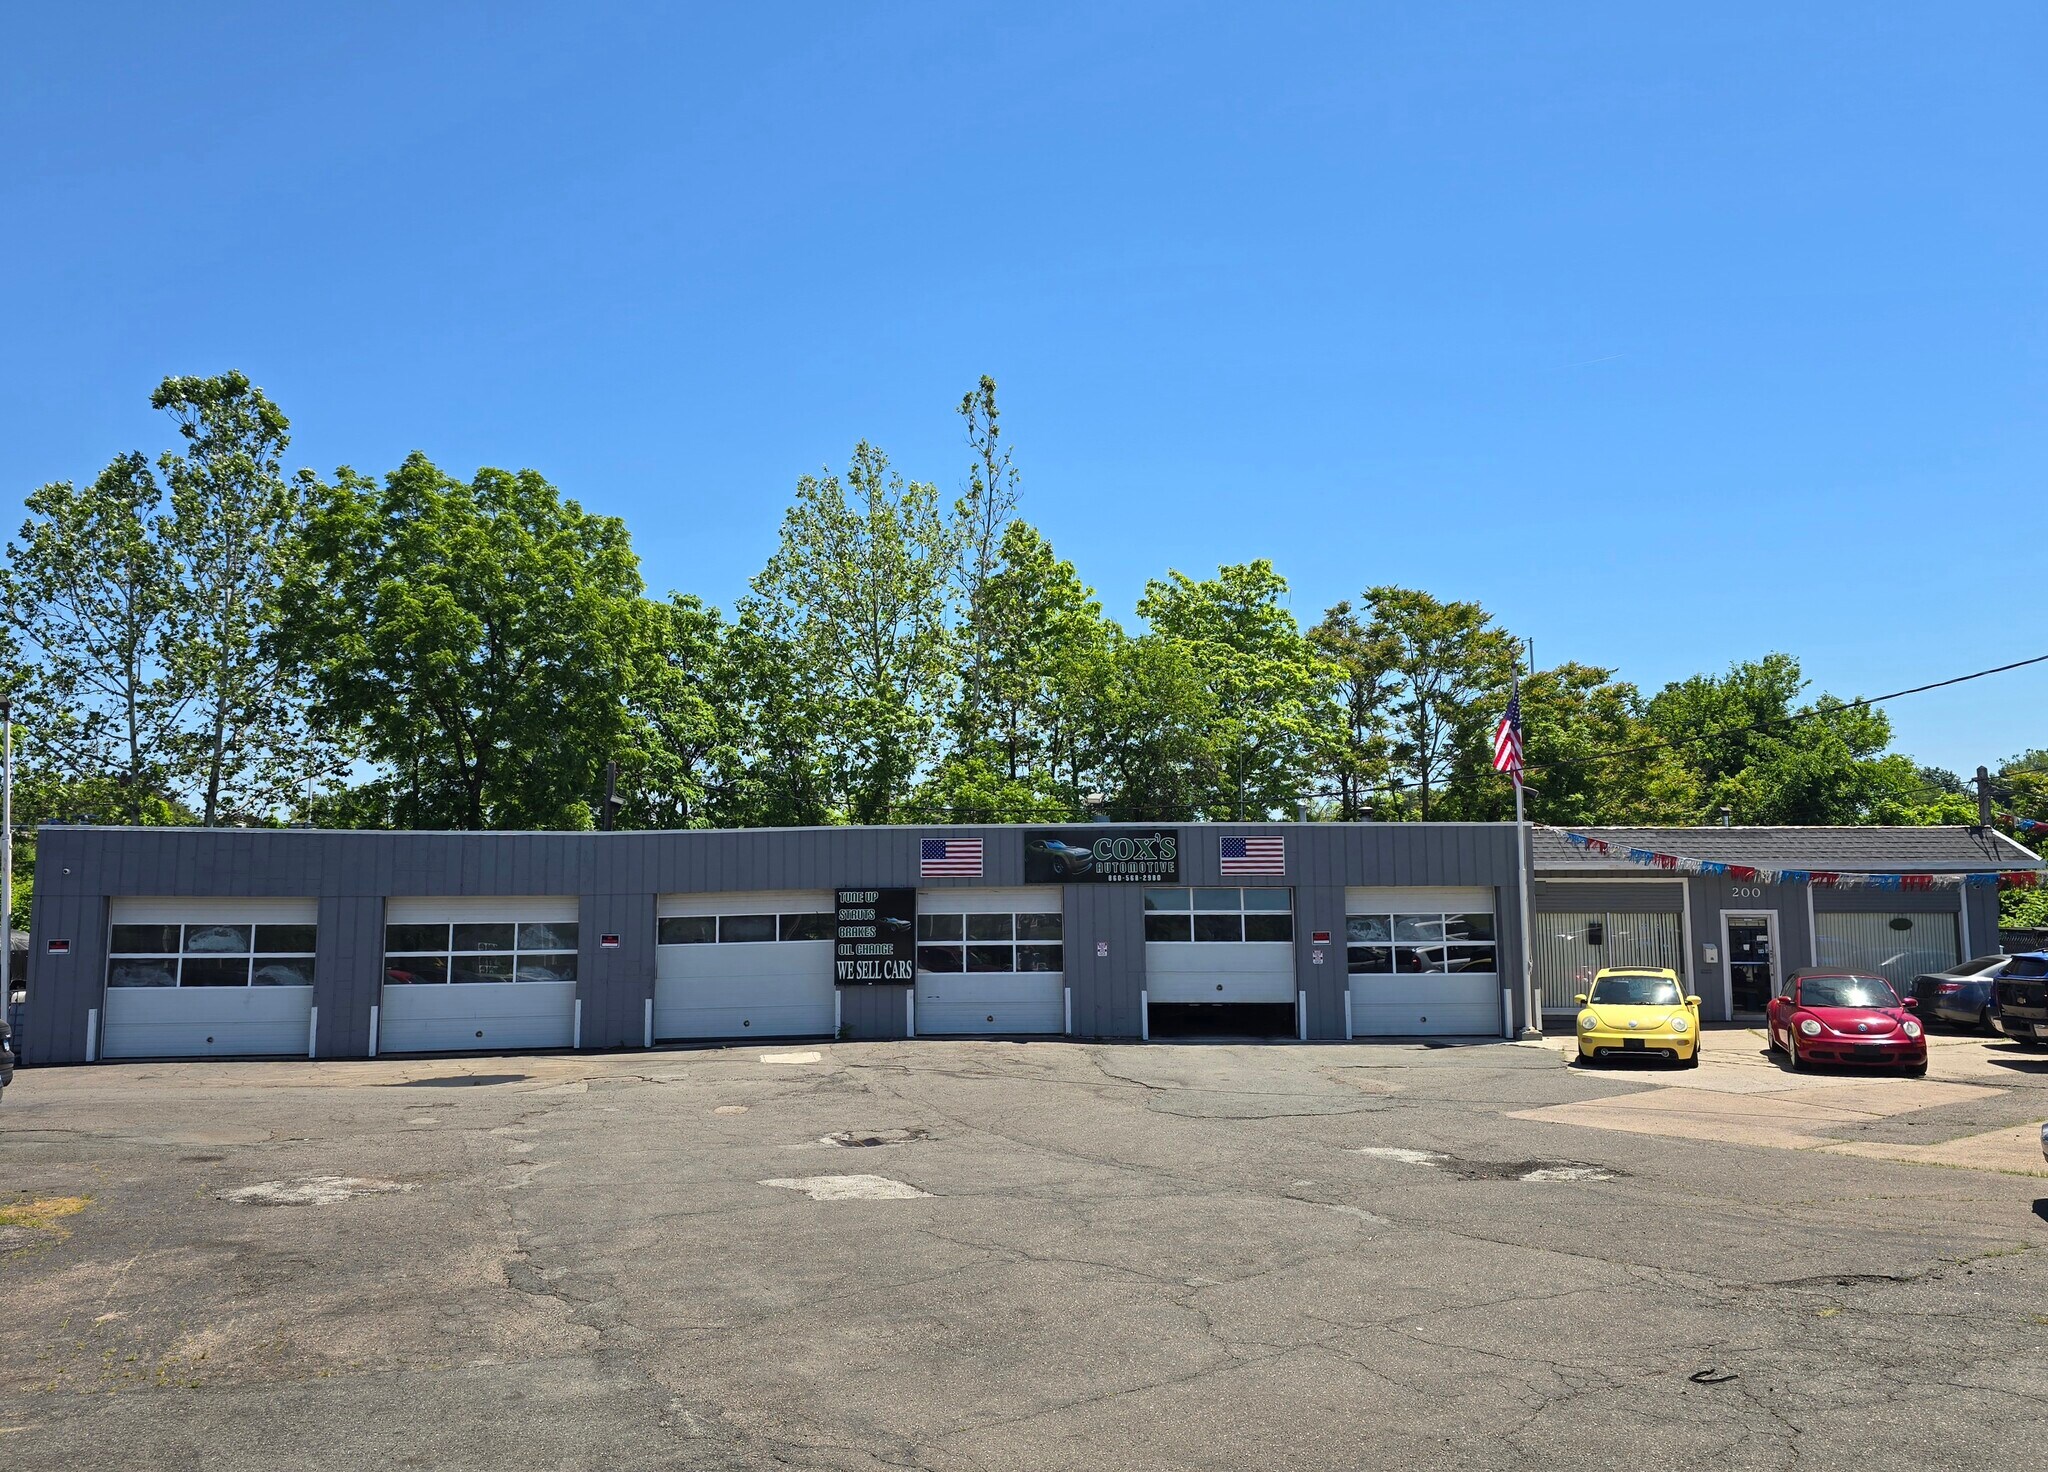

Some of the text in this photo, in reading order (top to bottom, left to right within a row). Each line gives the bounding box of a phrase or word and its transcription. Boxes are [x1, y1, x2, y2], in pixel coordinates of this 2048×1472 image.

[1093, 833, 1177, 861] COX'S
[1096, 861, 1175, 873] AUTOMOTIVE
[839, 891, 879, 903] TUNE UP
[1732, 887, 1761, 898] 200
[839, 909, 876, 920] STRUTS
[838, 926, 876, 938] BRAKES
[838, 943, 894, 955] OIL CHANGE
[837, 960, 912, 980] WE SELL CARS
